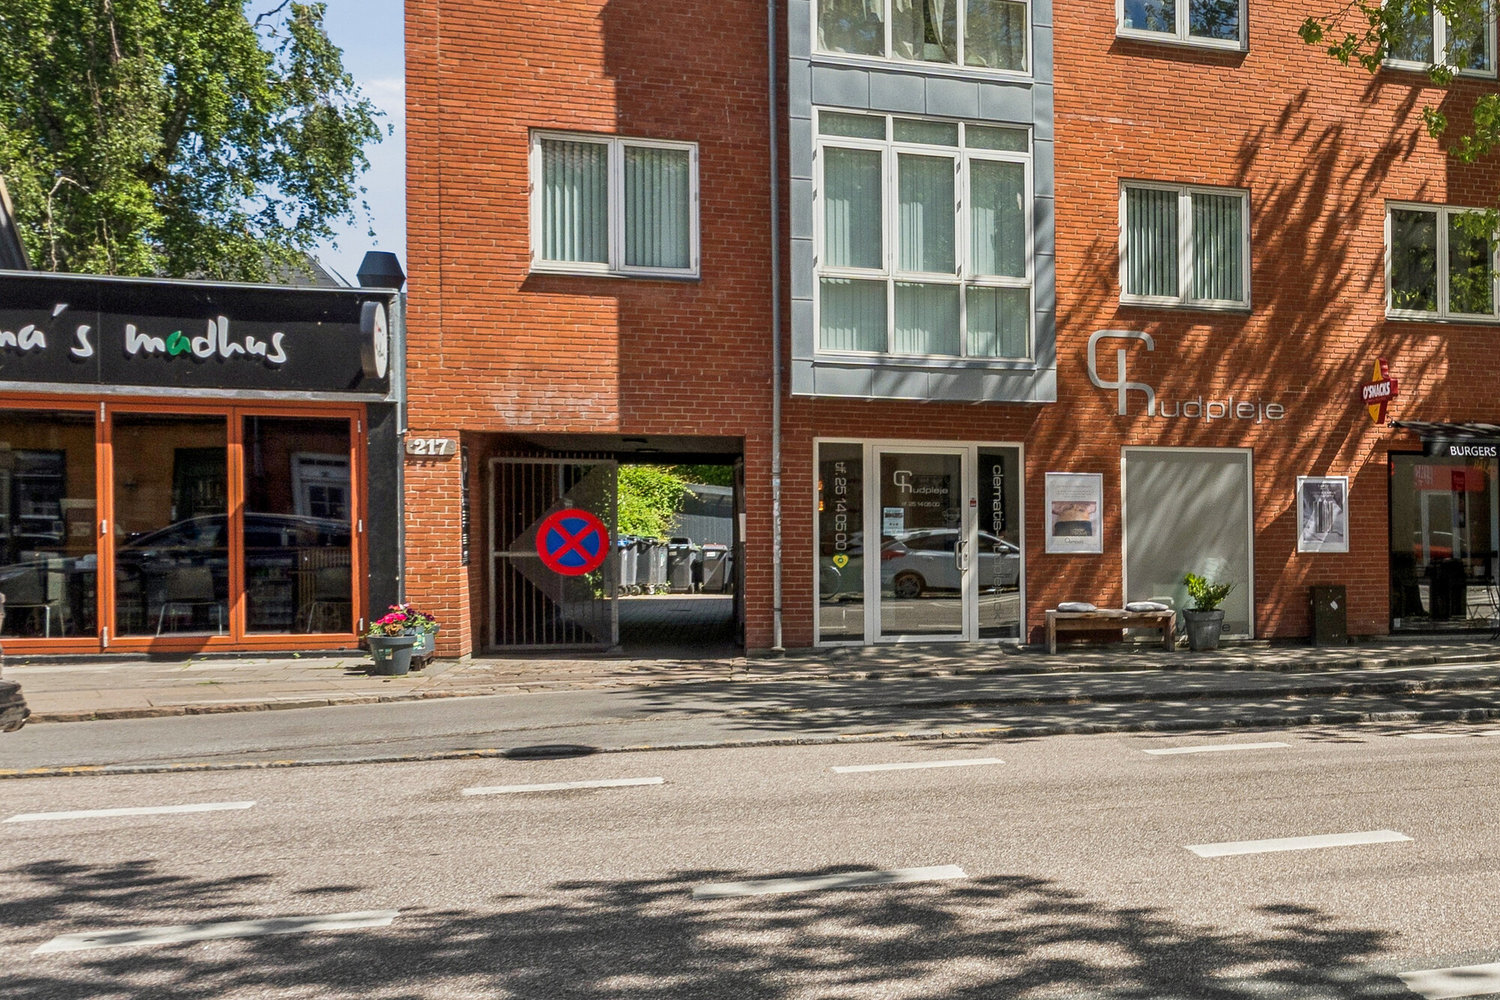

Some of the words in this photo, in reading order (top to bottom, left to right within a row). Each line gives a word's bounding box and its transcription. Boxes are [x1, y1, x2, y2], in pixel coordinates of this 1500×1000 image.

[126, 315, 287, 363] madhus
[413, 438, 449, 455] 217
[1450, 446, 1497, 457] BURGERS
